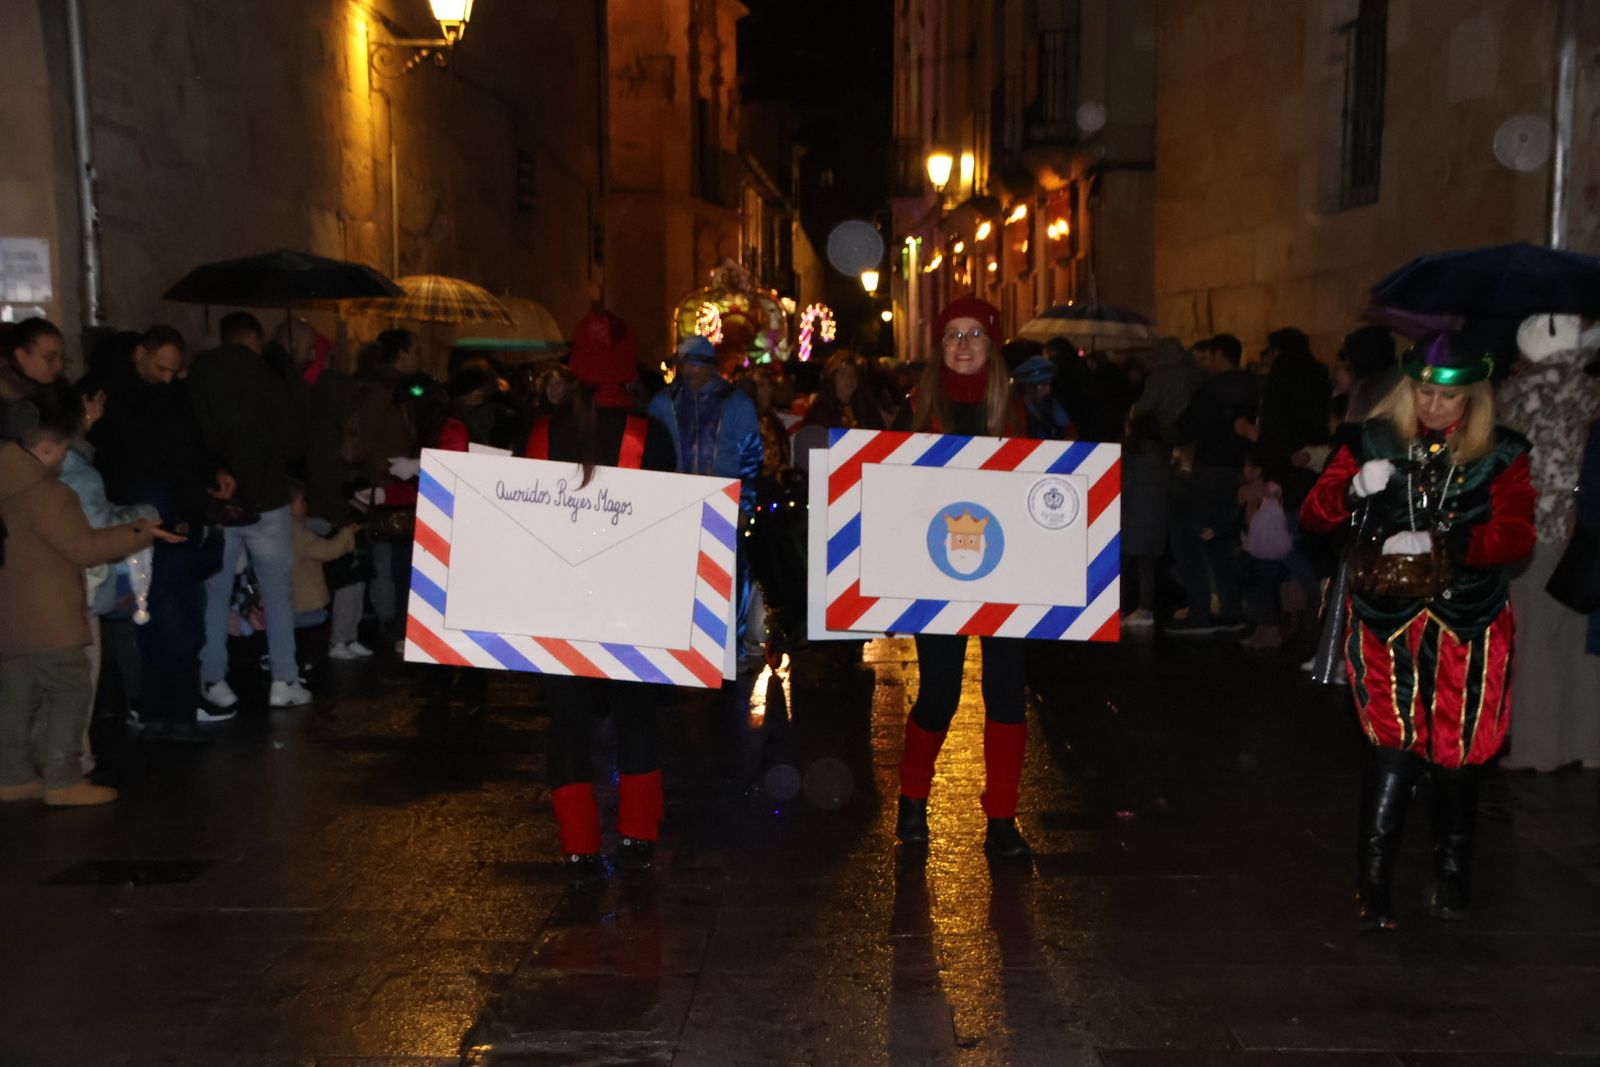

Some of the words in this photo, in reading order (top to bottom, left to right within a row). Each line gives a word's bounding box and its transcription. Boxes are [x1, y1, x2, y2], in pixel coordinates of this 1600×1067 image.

[496, 478, 551, 505] Queridos
[554, 478, 592, 523] Reyes
[594, 488, 633, 526] Magos
